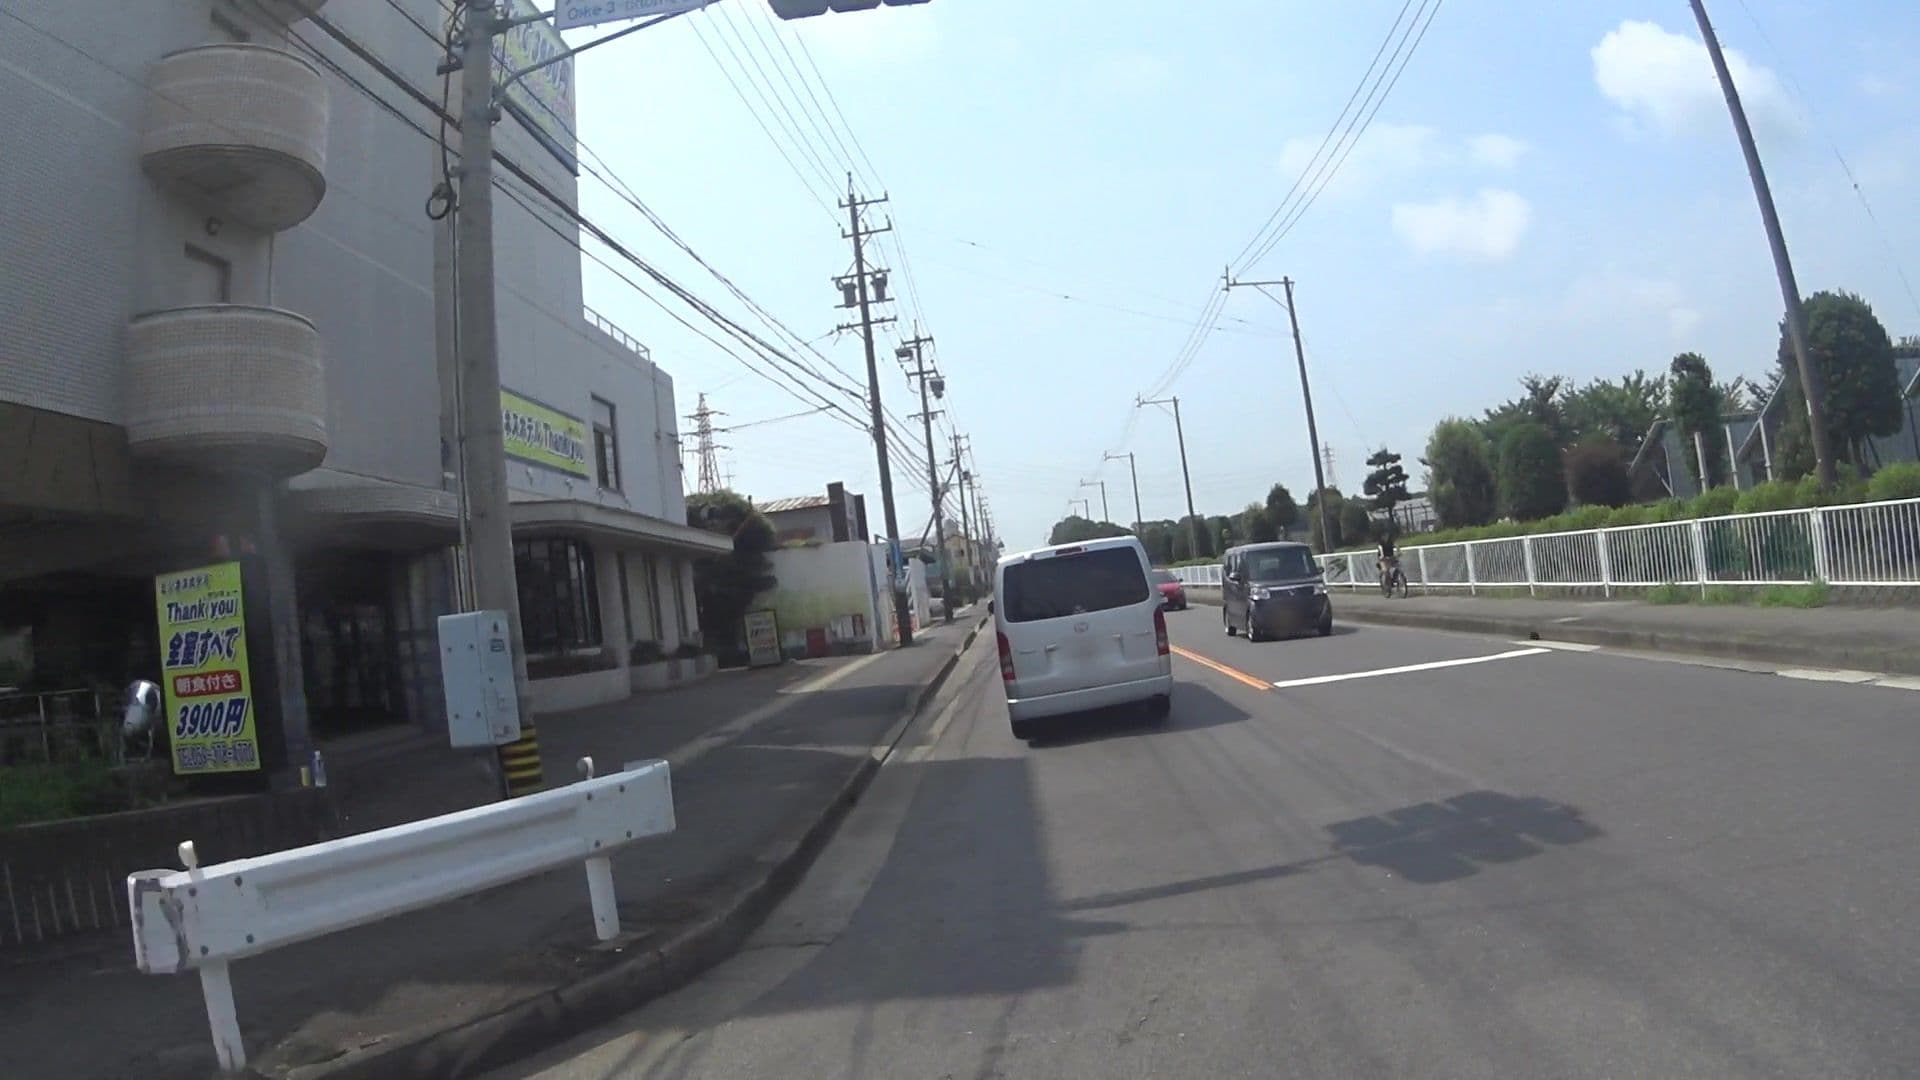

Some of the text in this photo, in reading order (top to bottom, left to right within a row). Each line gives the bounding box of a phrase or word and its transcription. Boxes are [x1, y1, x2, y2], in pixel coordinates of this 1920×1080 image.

[167, 598, 236, 623] Thank you
[176, 674, 236, 693] 朝食付き
[176, 697, 248, 738] 3900円
